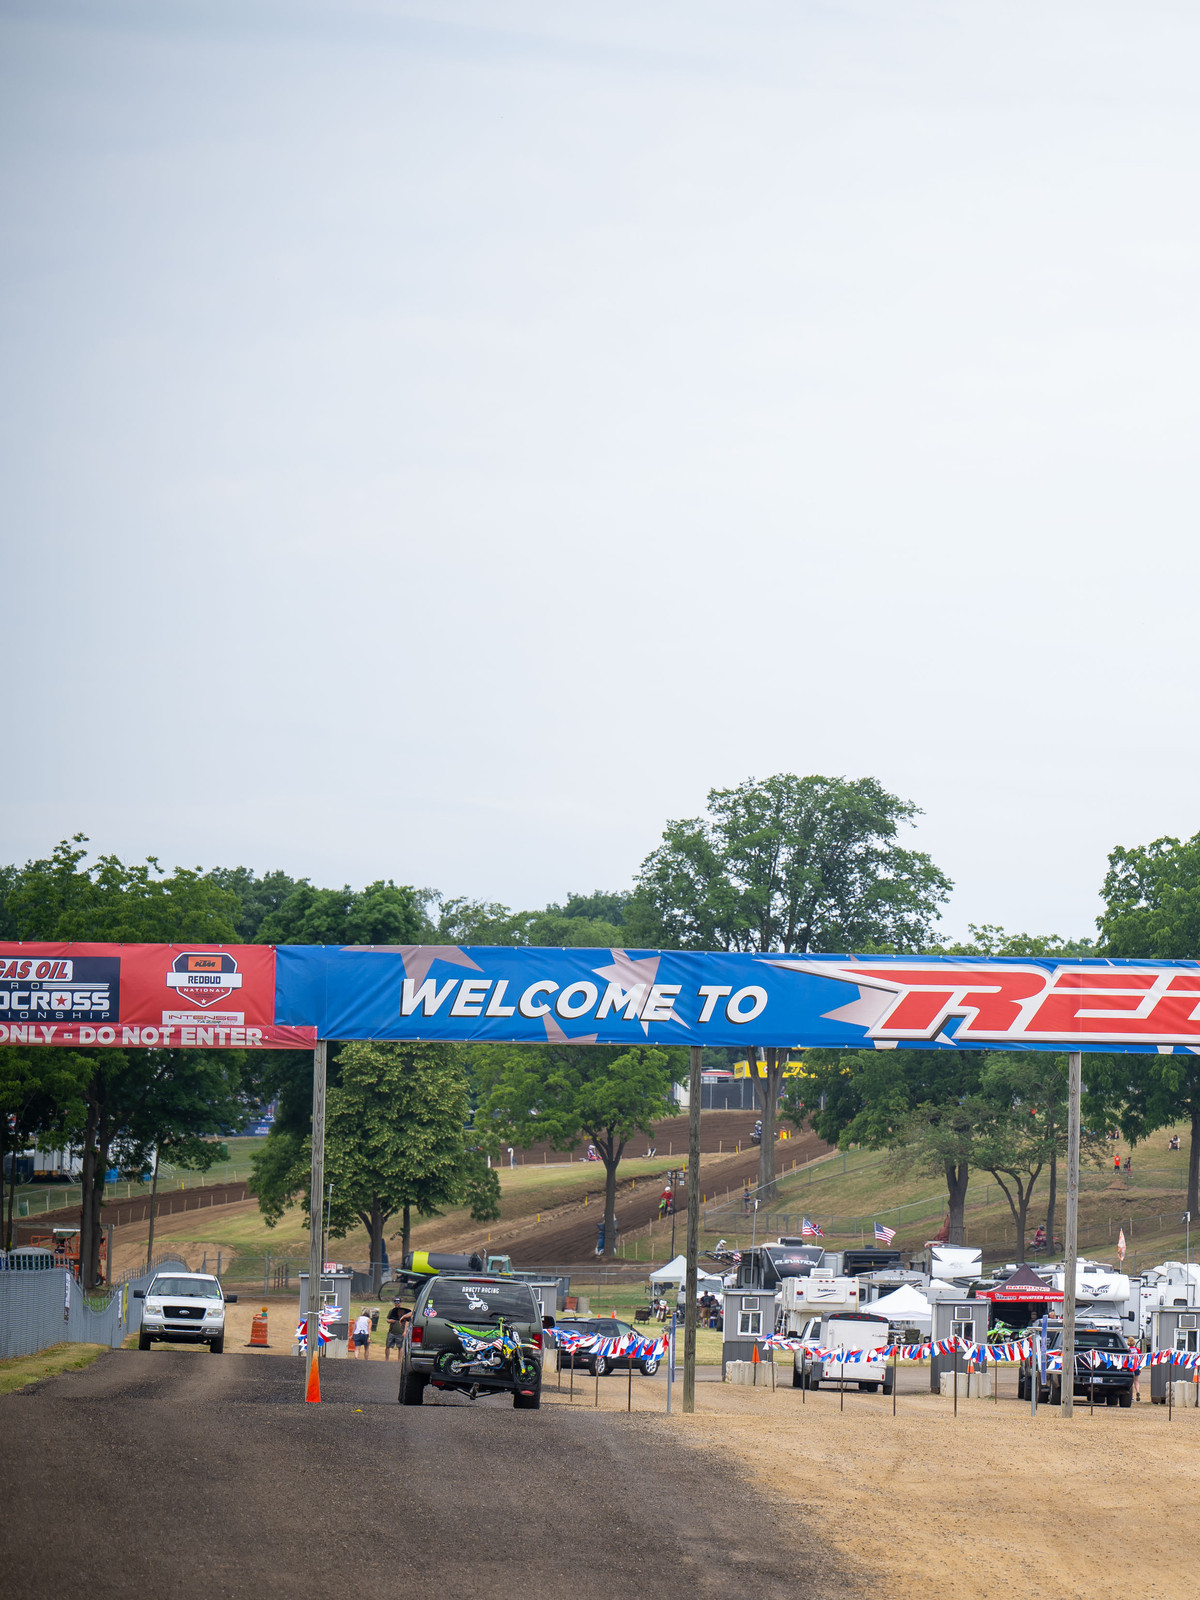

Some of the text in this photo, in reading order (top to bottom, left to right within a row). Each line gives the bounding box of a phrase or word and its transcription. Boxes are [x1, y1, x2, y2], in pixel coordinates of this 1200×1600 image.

[35, 961, 68, 979] OIL
[188, 976, 221, 984] REDBUD
[401, 979, 768, 1024] WELCOME TO
[79, 1026, 116, 1045] DO
[121, 1027, 175, 1046] NOT
[181, 1027, 263, 1046] ENTER
